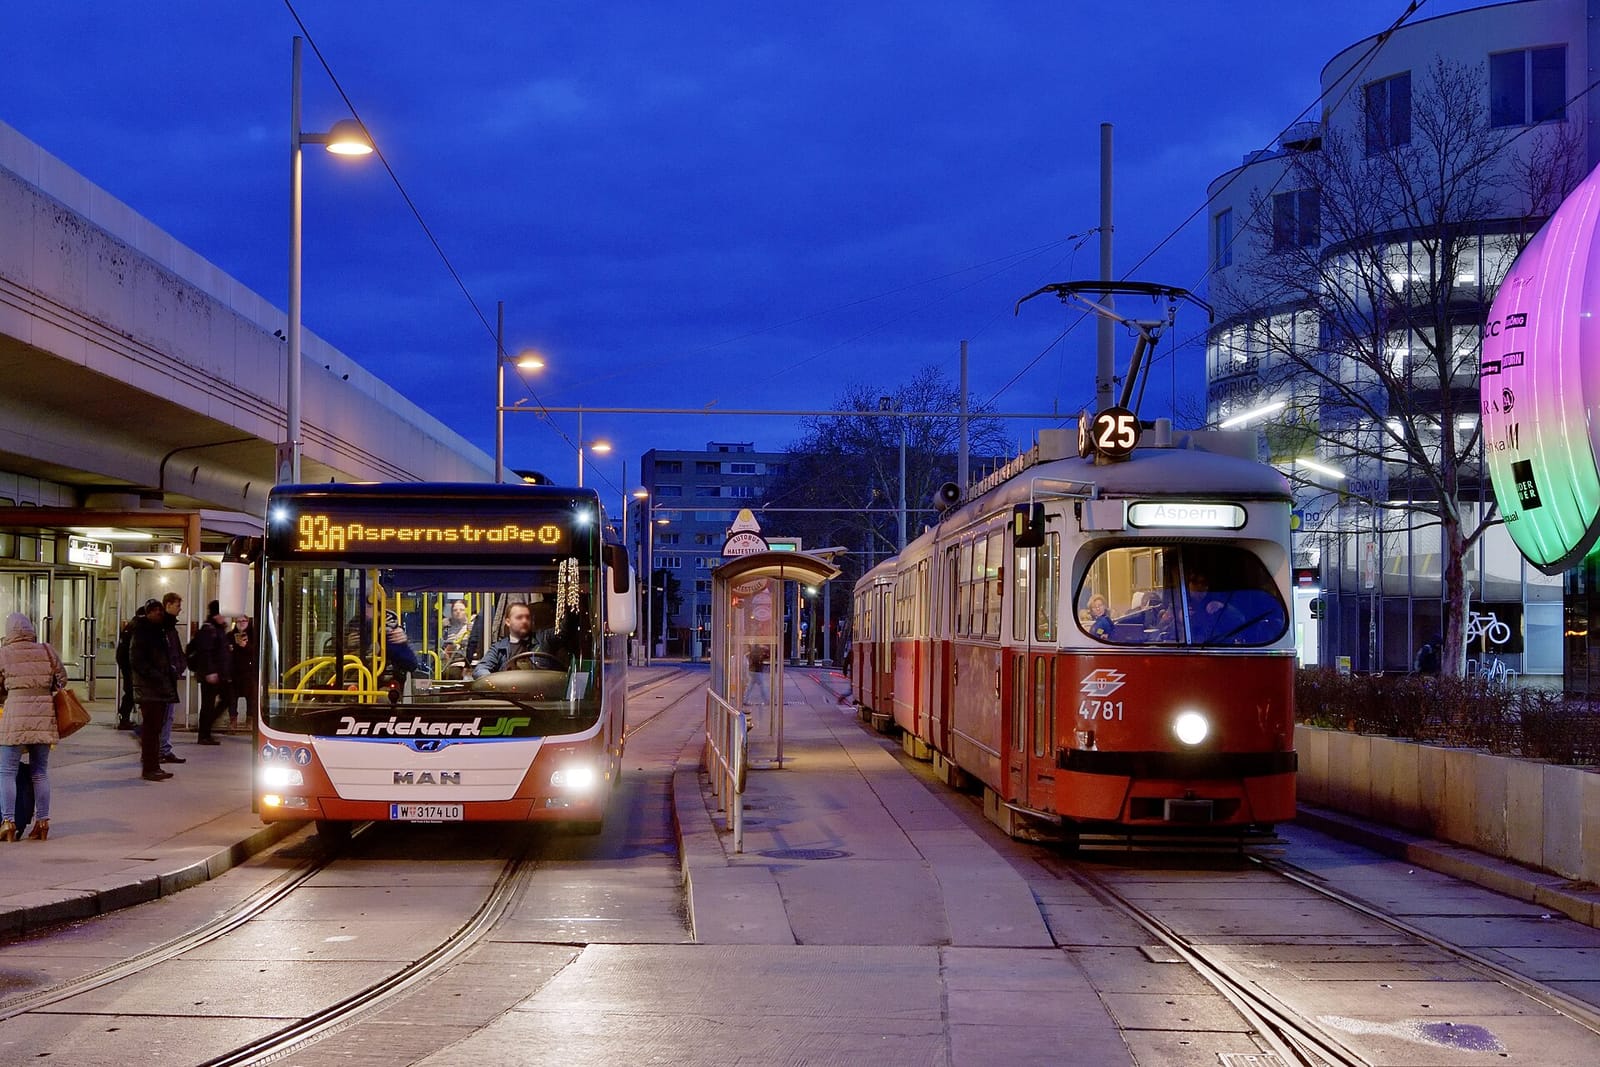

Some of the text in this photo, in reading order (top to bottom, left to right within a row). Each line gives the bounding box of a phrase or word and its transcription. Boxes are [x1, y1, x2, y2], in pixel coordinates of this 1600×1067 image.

[1098, 415, 1135, 448] 25
[1154, 505, 1217, 520] Aspern
[299, 515, 345, 550] 93A
[347, 524, 536, 542] Aspernstraße
[733, 534, 760, 544] AUTOBUS
[1079, 700, 1123, 721] 4781
[393, 771, 460, 785] MAN
[401, 806, 408, 817] W
[417, 806, 443, 818] 3174
